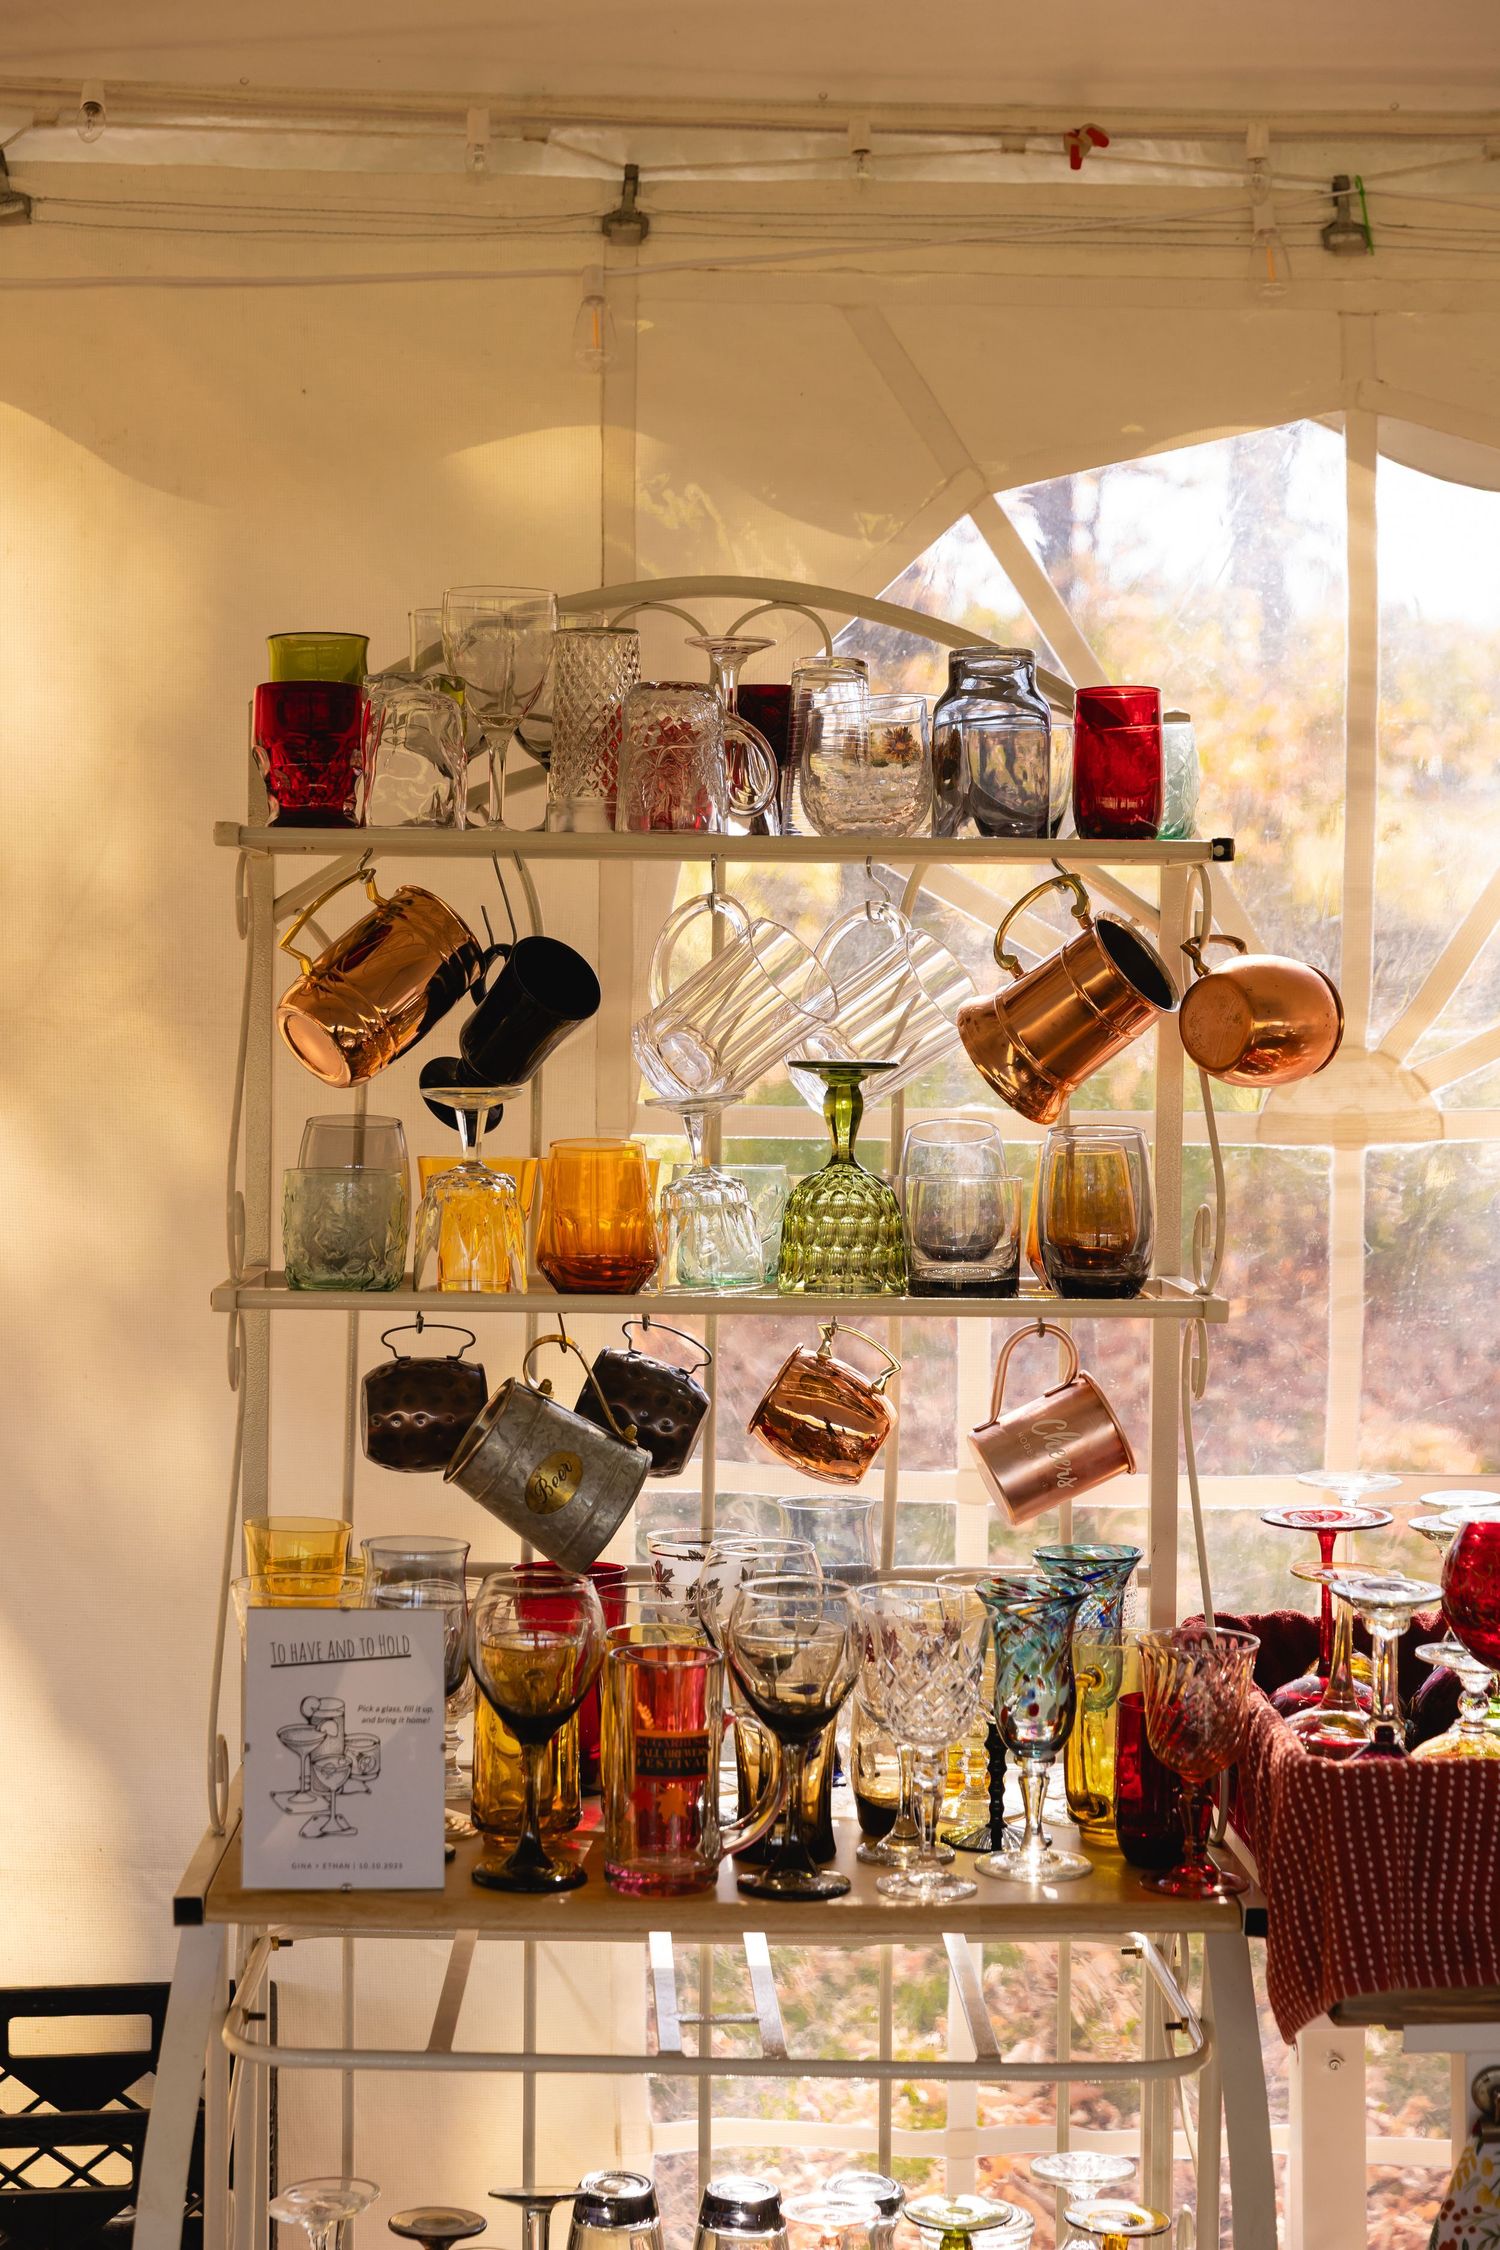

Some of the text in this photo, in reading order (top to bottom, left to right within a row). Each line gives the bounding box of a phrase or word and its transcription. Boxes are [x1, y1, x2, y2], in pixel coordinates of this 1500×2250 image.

[1031, 1418, 1081, 1488] Cheers
[534, 1460, 573, 1504] Beer
[328, 1638, 355, 1660] AND
[378, 1633, 410, 1656] HOLD
[357, 1704, 373, 1713] Pick
[403, 1704, 414, 1713] fill
[361, 1715, 376, 1724] and
[377, 1715, 397, 1725] bring
[406, 1715, 431, 1724] home!
[322, 1861, 350, 1870] ETHAN
